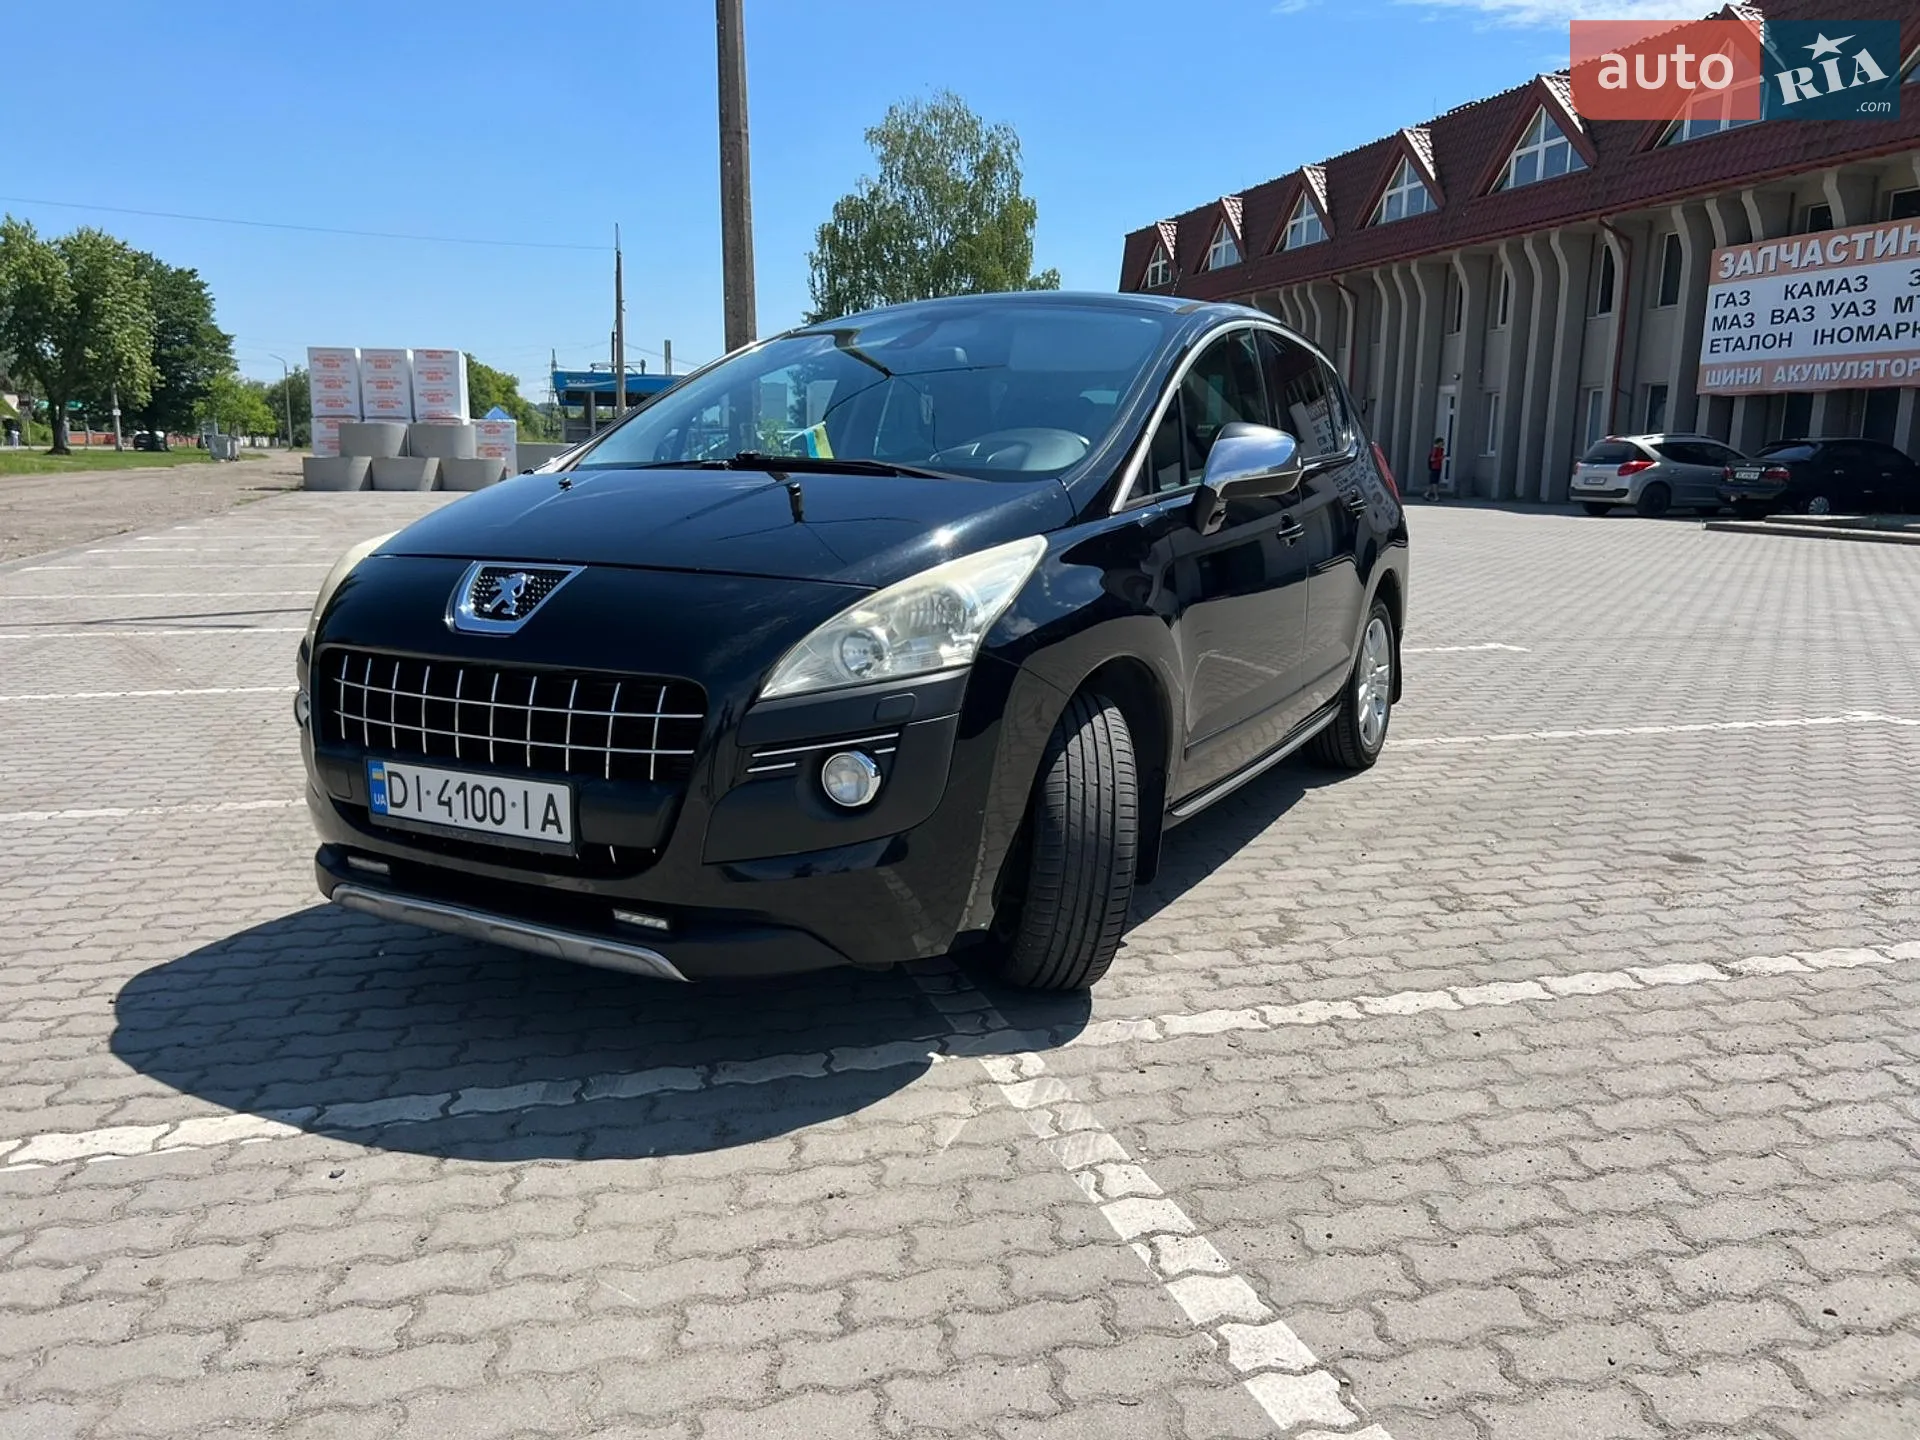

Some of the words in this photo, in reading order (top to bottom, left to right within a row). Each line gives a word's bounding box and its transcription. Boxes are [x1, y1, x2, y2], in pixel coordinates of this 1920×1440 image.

[1718, 224, 1920, 279] ЗАПЧАСТИН
[1714, 290, 1752, 309] ГАЗ
[1784, 275, 1868, 300] КАМАЗ
[1711, 312, 1755, 331] МАЗ
[1770, 305, 1815, 325] ВАЗ
[1830, 299, 1876, 319] УАЗ
[1893, 295, 1920, 314] М
[1709, 331, 1793, 354] ЕТАЛОН
[1705, 366, 1763, 387] ШИНИ
[1773, 357, 1920, 383] АКУМУЛЯТОР
[373, 793, 387, 806] UA
[437, 779, 506, 826] 4100
